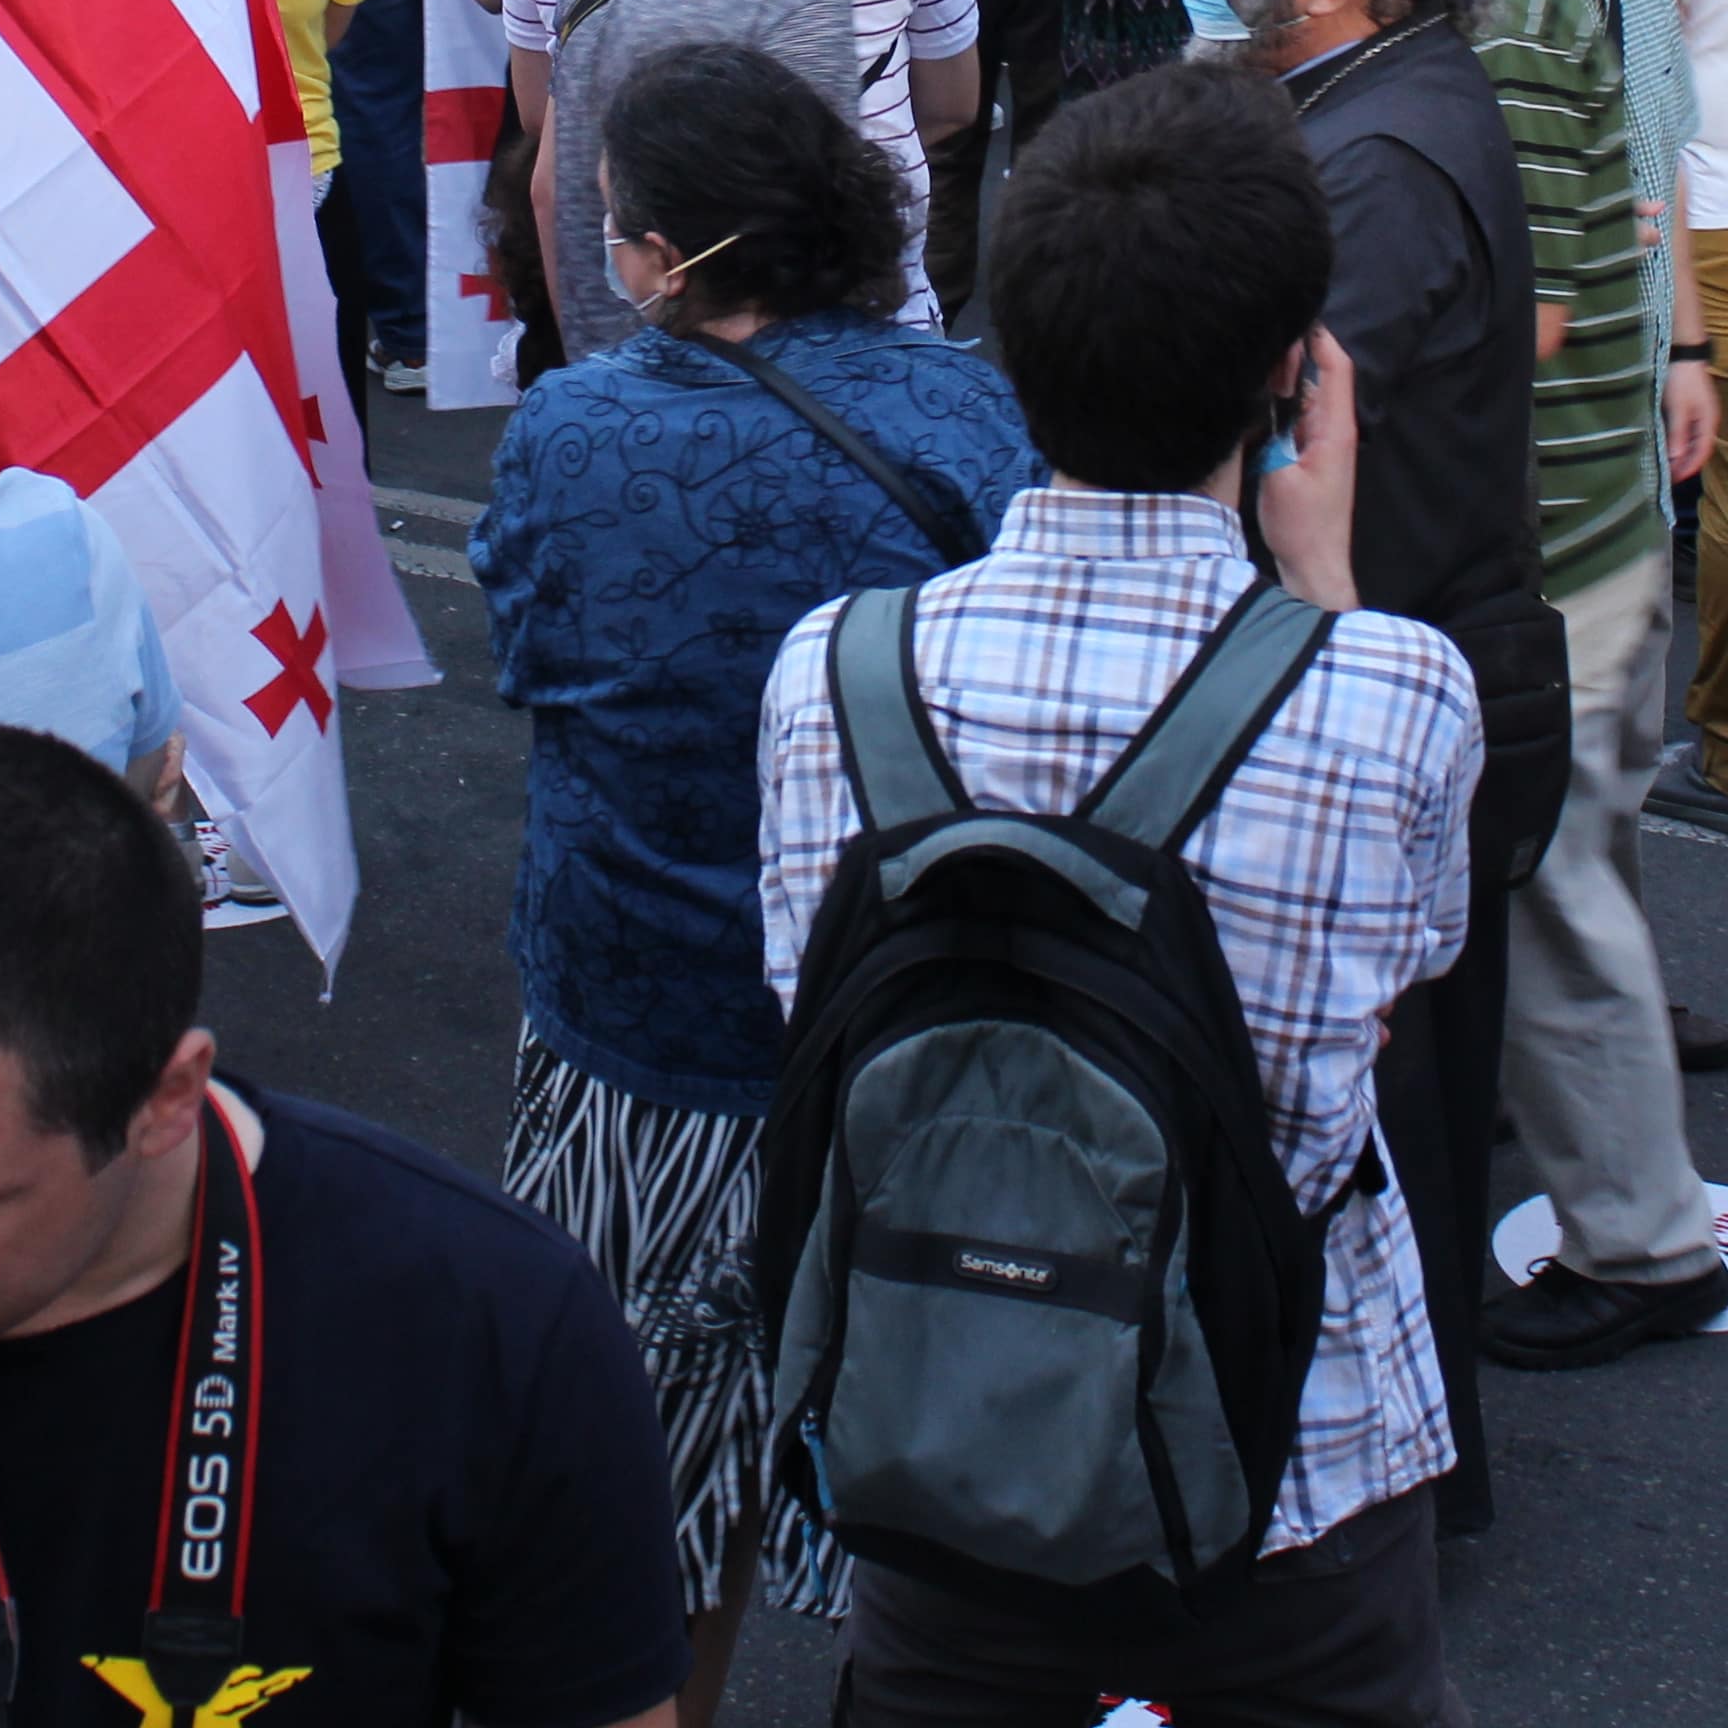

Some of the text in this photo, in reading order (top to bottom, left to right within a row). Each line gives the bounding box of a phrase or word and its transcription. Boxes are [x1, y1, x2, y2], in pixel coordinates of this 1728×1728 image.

[181, 1241, 239, 1580] EOS 5D Mark IV
